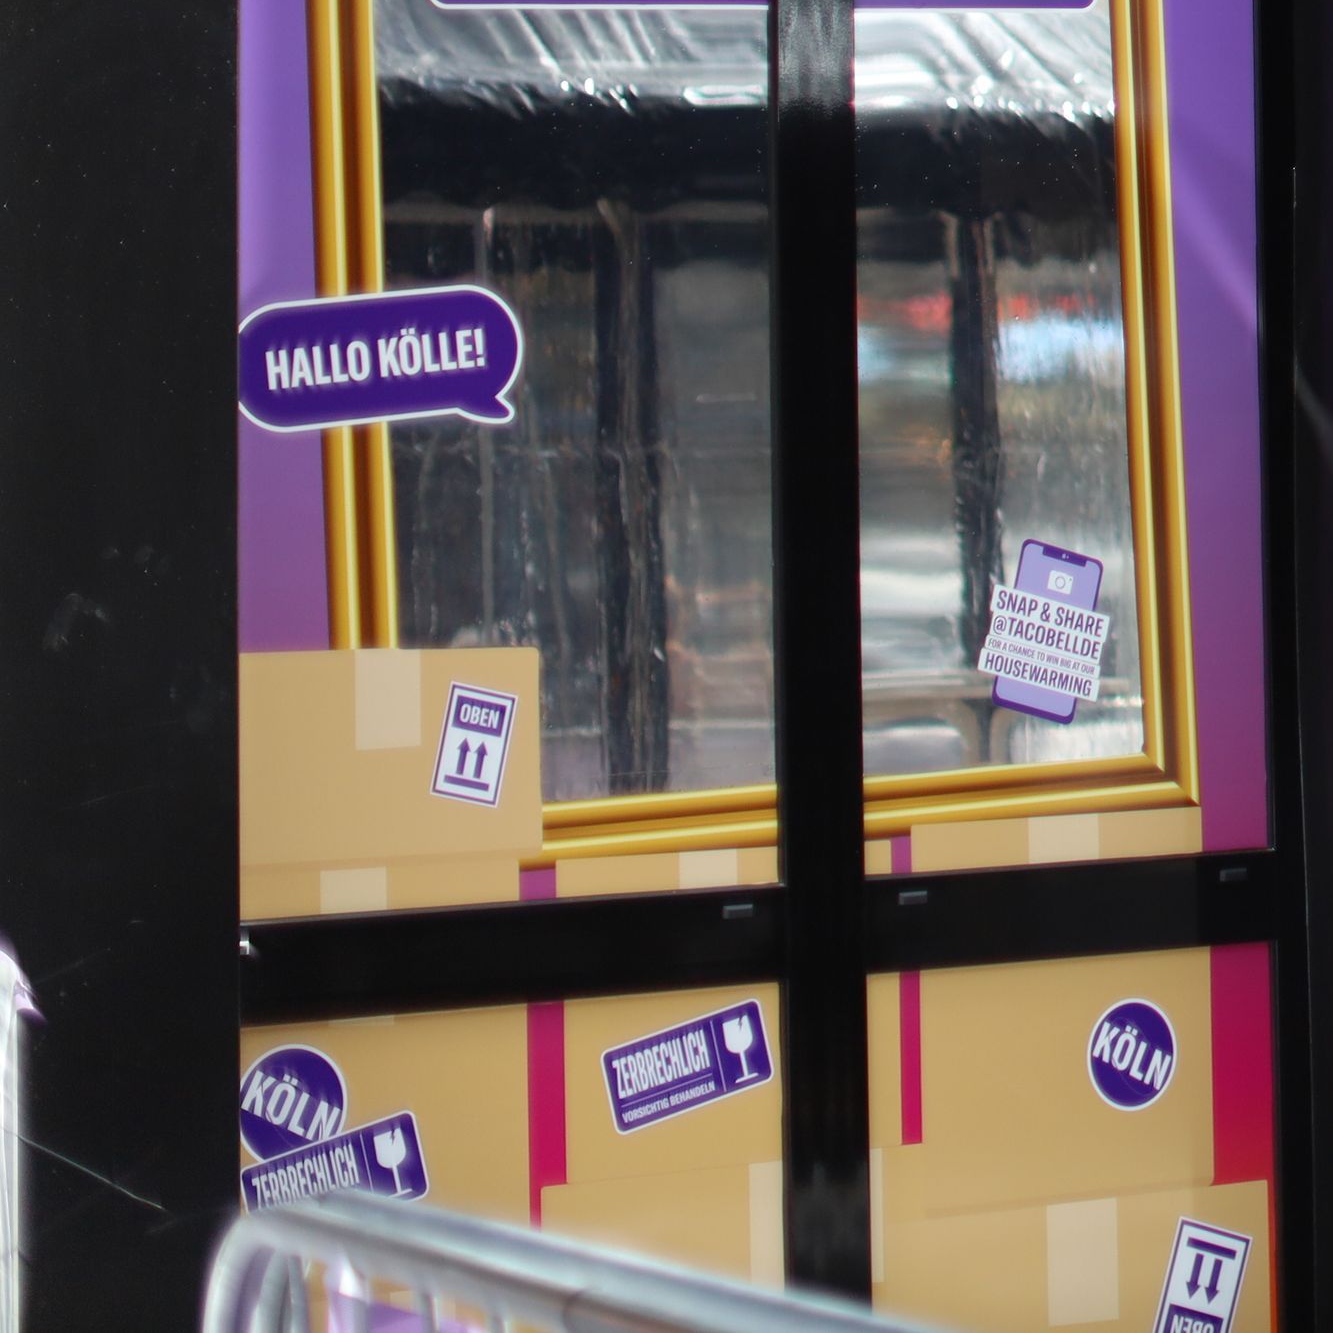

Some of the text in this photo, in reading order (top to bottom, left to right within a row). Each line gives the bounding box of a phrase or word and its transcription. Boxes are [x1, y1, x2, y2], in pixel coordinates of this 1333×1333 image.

[265, 327, 486, 391] HALLO KÖLLE!
[996, 589, 1104, 637] SNAP & SHARE
[988, 637, 1001, 650] FOR
[1008, 643, 1036, 660] CHANCE
[992, 615, 1101, 660] @TACOBELLDE
[984, 653, 1092, 697] HOUSEWARMING
[460, 704, 500, 729] OBEN
[611, 1030, 711, 1100] ZERBRECHLICH
[1093, 1021, 1172, 1091] KÖLN
[241, 1070, 341, 1141] KÖLN
[622, 1081, 716, 1124] VORSICHTIG BEHANDELN
[252, 1143, 360, 1211] ZERBRECHLICH
